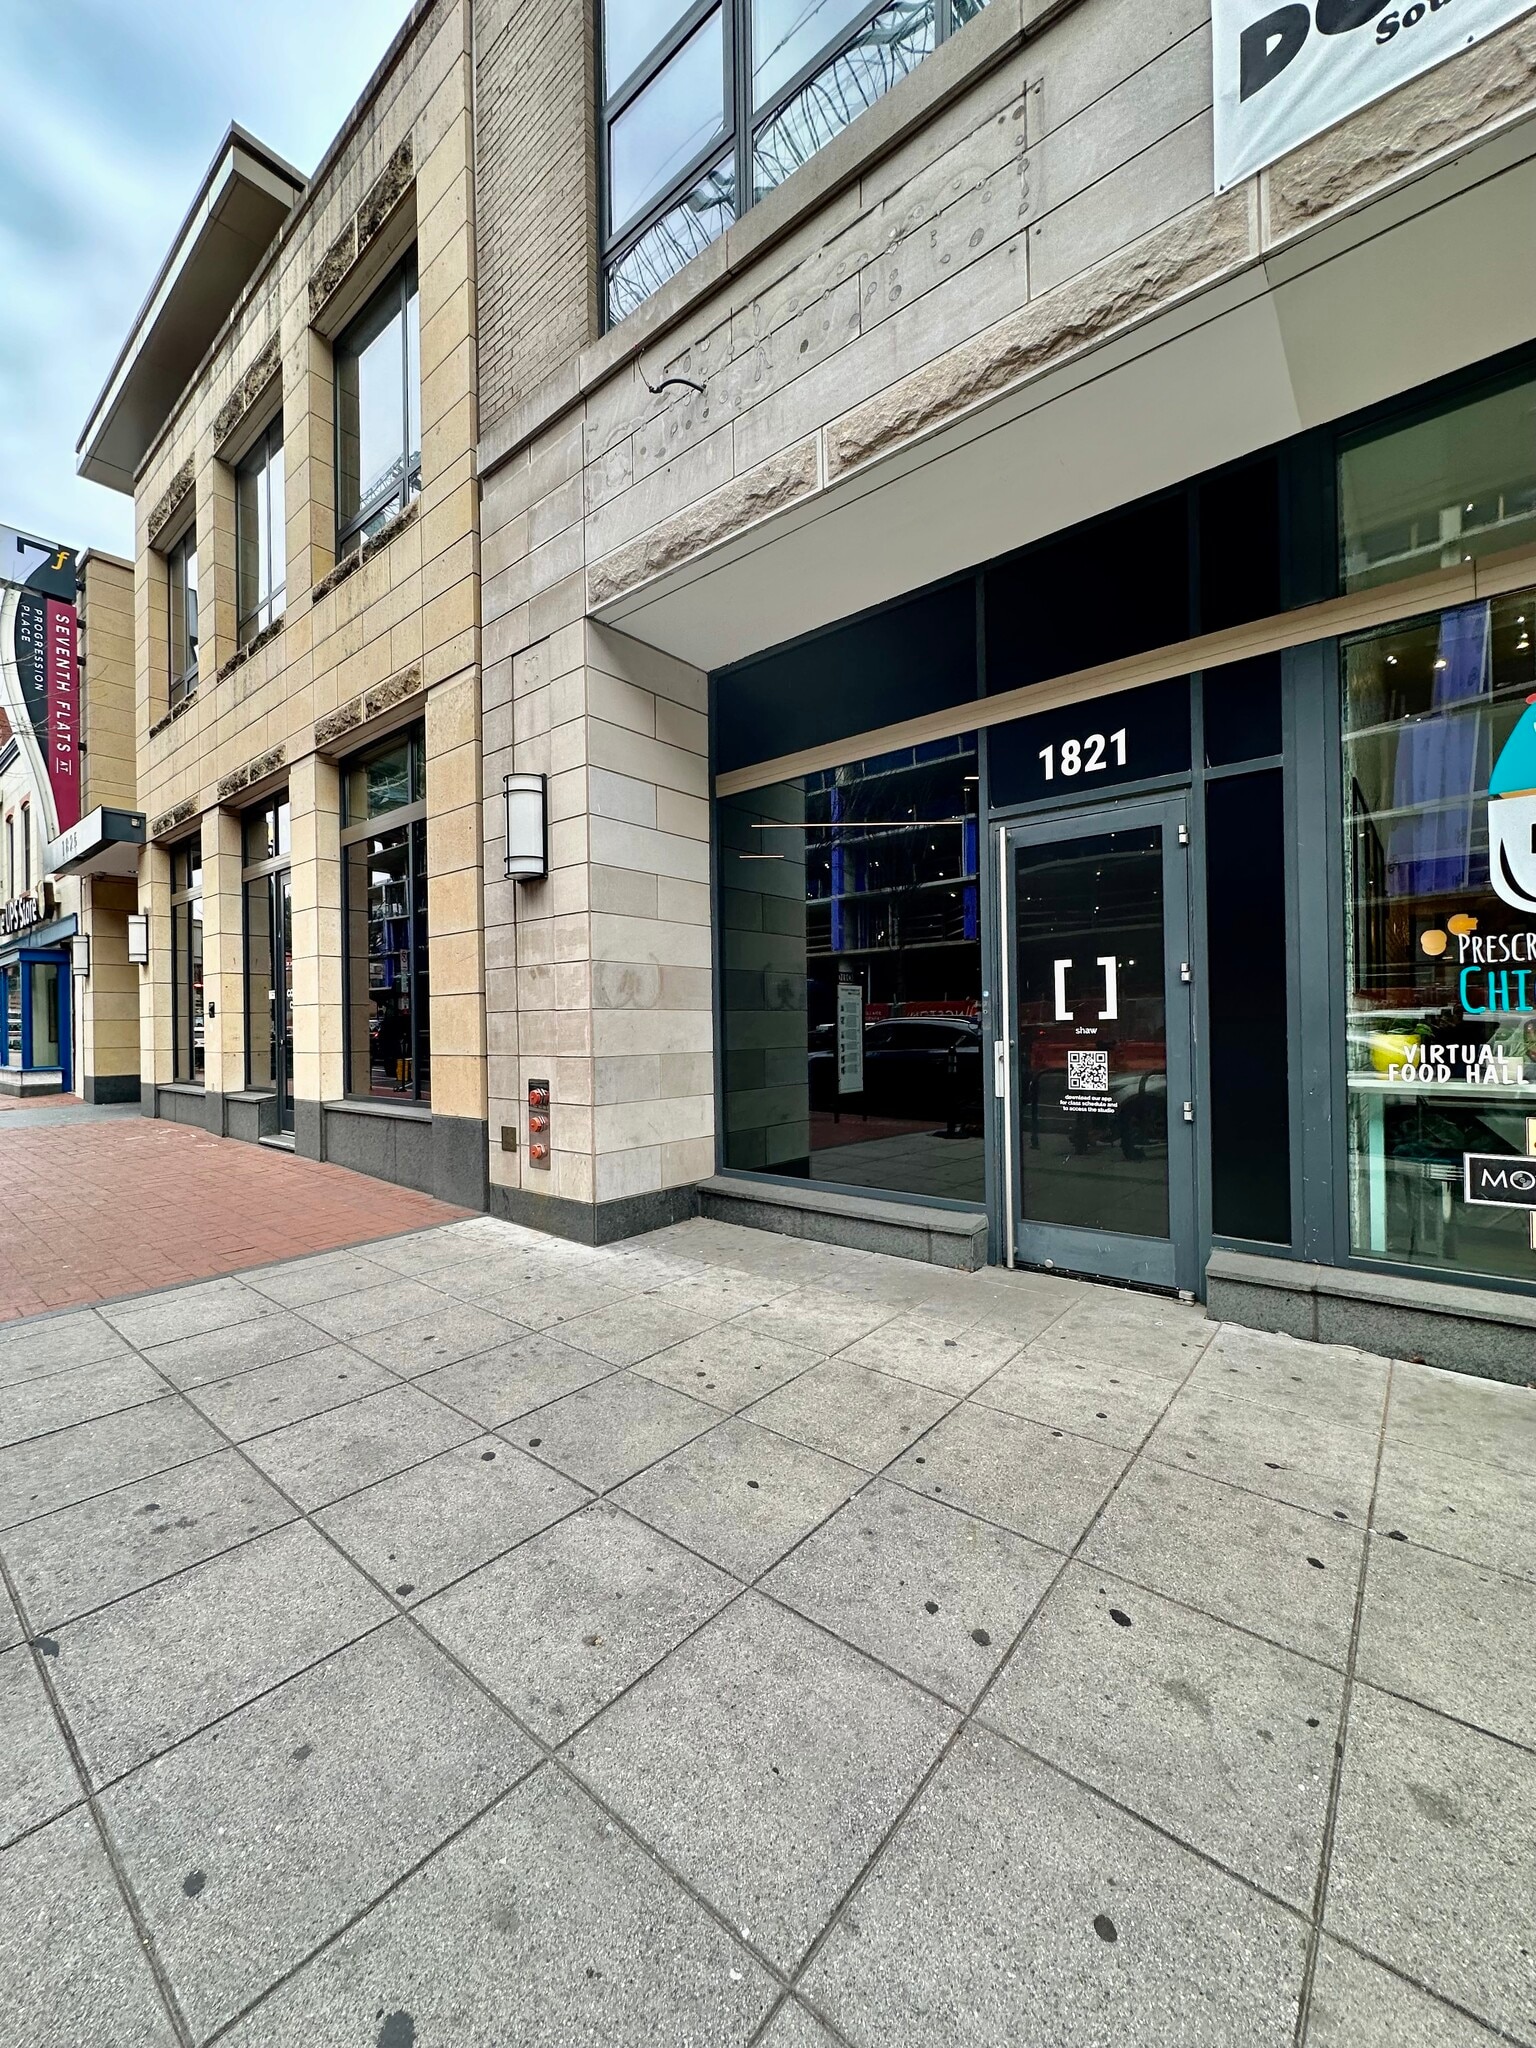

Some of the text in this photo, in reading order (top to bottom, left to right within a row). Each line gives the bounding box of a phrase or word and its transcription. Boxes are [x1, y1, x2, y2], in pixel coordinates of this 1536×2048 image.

[21, 604, 31, 643] PLACE
[34, 608, 44, 691] PROGRESSION
[55, 613, 71, 773] SEVENTH FLATS AT
[1038, 728, 1126, 780] 1821
[6, 899, 19, 933] UPS
[19, 897, 37, 928] Store
[1459, 966, 1536, 1014] CHI
[1075, 1026, 1098, 1035] shaw
[1403, 1044, 1509, 1065] VIRTUAL
[1388, 1063, 1530, 1085] FOOD HALL
[1481, 1168, 1536, 1190] MO
